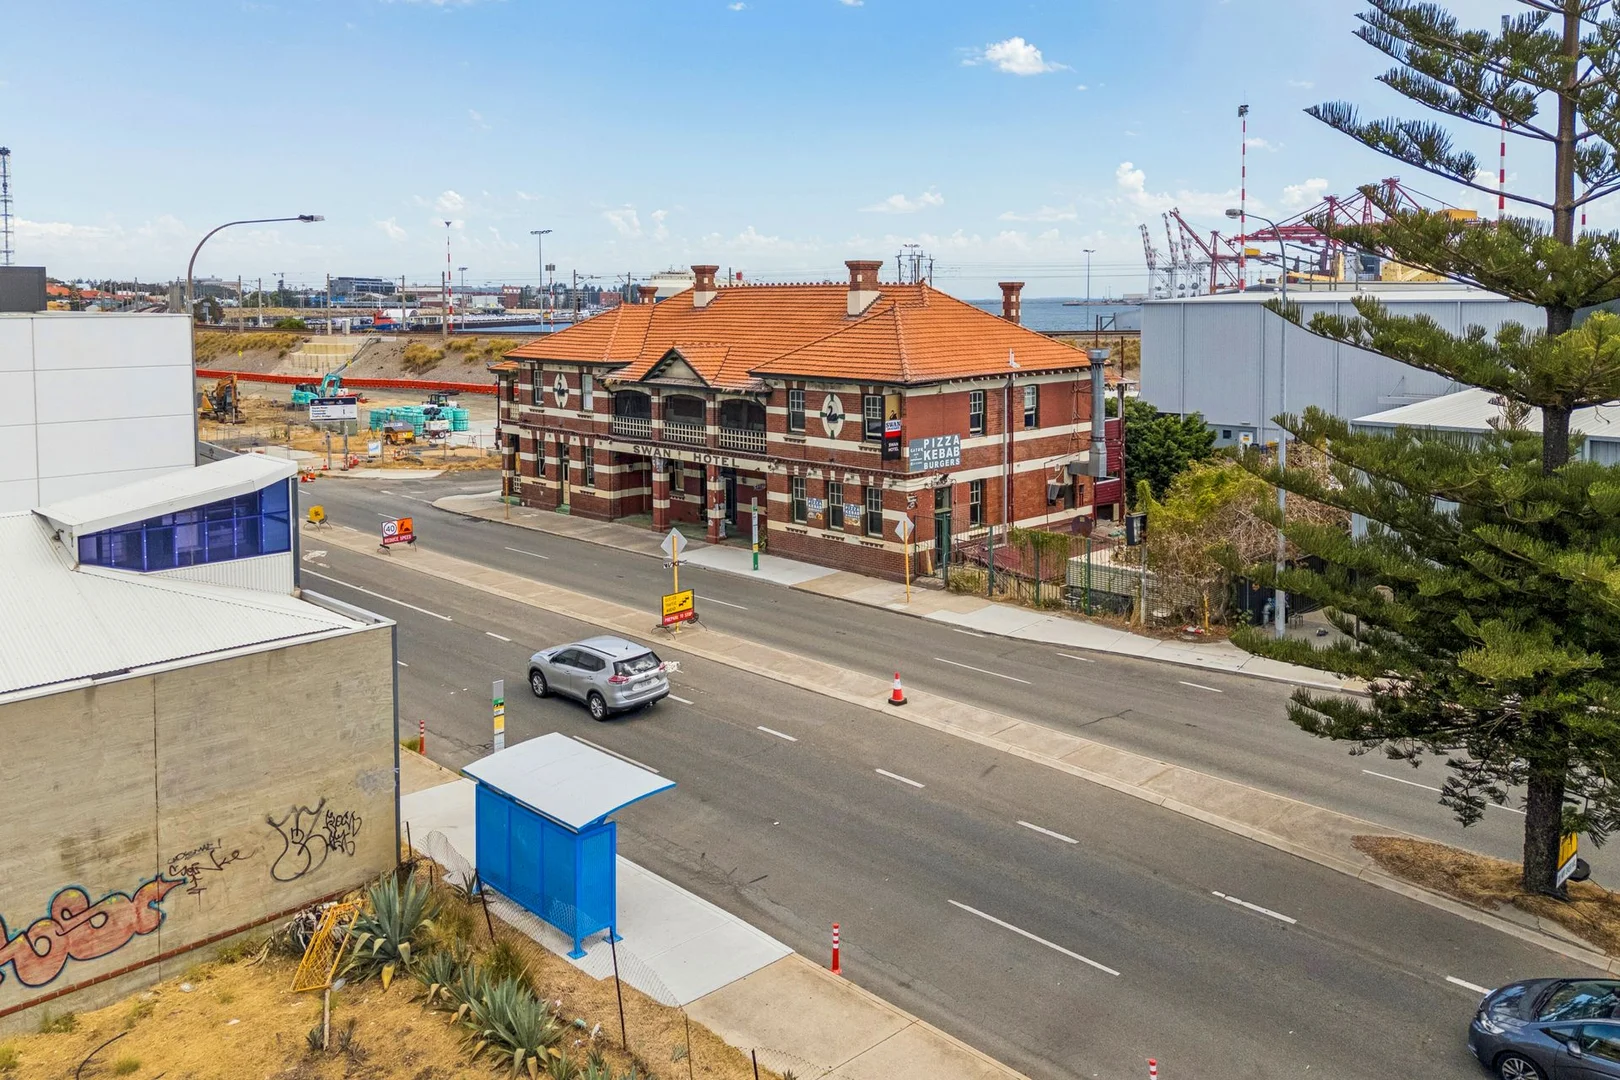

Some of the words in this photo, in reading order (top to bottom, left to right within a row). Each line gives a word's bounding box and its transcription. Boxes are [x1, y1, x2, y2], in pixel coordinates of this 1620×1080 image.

[923, 435, 960, 449] PIZZA
[633, 445, 671, 458] SWAN
[693, 453, 740, 468] HOTEL
[923, 446, 960, 461] KEBAB
[923, 458, 960, 470] BURGERS
